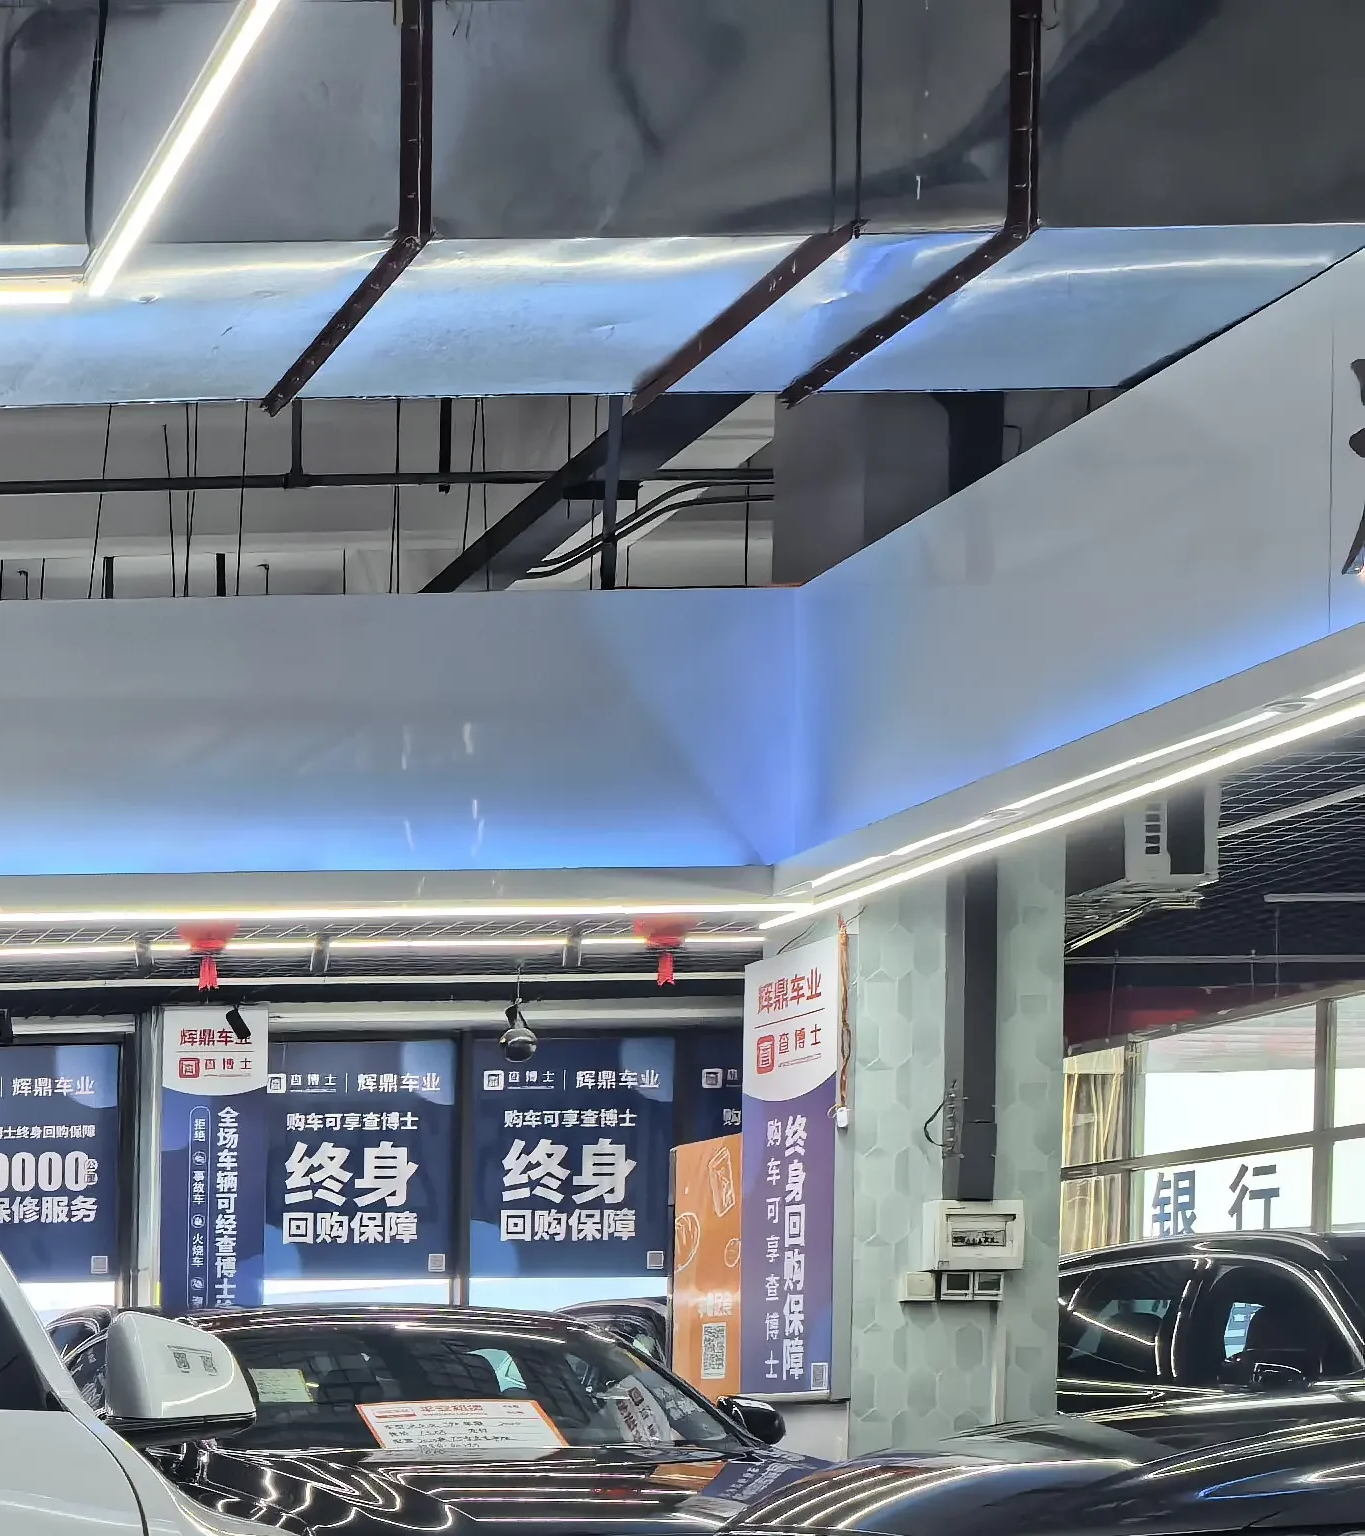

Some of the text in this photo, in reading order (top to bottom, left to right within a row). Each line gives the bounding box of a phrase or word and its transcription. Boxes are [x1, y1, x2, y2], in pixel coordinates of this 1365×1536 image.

[757, 966, 822, 1015] 辉鼎车业
[12, 1076, 96, 1097] 辉鼎车业
[356, 1072, 441, 1093] 辉鼎车业
[575, 1069, 661, 1090] 辉鼎车业
[286, 1111, 419, 1132] 购车可享查博士
[504, 1108, 638, 1129] 购车可享查博士
[284, 1140, 419, 1208] 终身
[501, 1137, 637, 1205] 终身
[1151, 1163, 1281, 1240] 银行
[282, 1210, 418, 1245] 回购保障
[500, 1208, 636, 1242] 回购保障
[764, 1118, 782, 1380] 购车可享查博士
[782, 1114, 808, 1381] 终身回购保障
